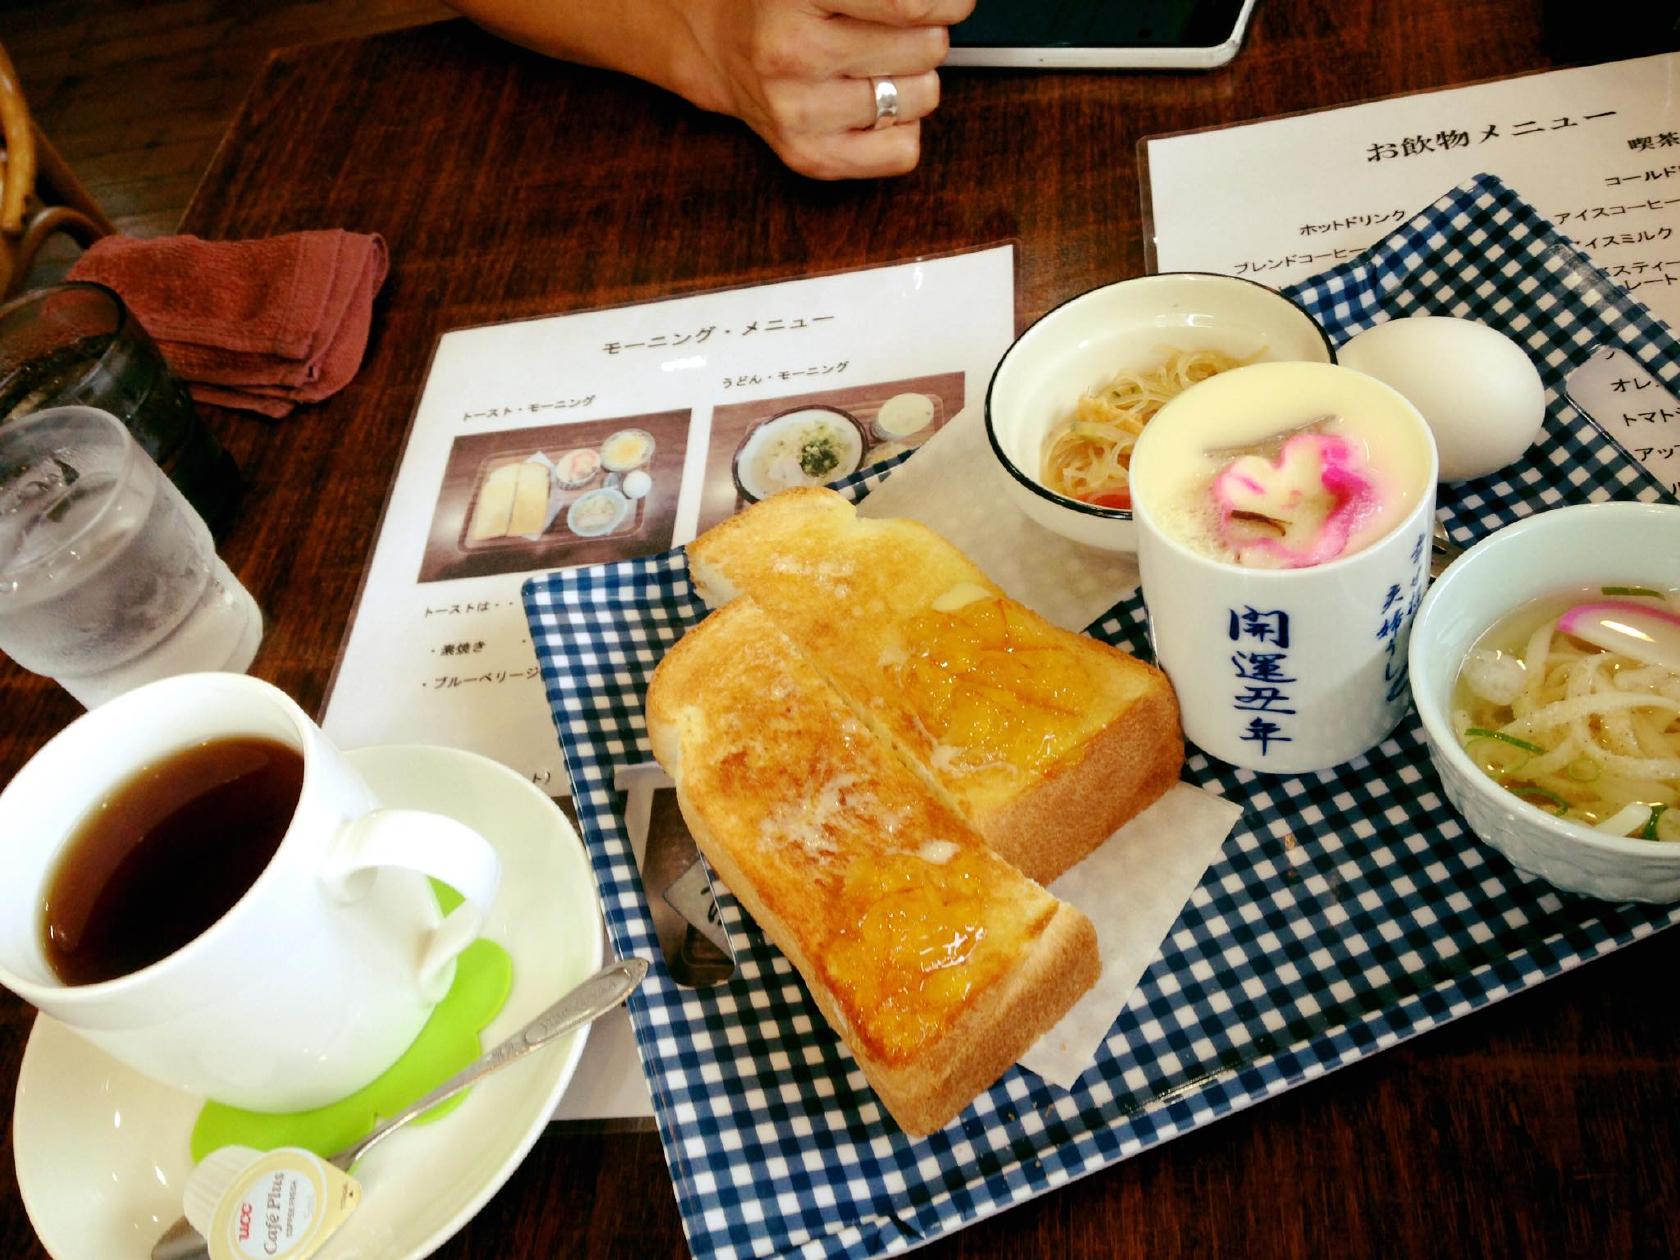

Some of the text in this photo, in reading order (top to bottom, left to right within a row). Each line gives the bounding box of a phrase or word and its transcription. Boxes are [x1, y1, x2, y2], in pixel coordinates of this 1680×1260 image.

[1366, 111, 1617, 162] お飲物メニュー
[1605, 165, 1680, 186] コールド
[1300, 210, 1405, 236] ホットドリンク
[1575, 227, 1672, 249] イスミルク
[1234, 248, 1367, 275] ブレンドコーヒー
[602, 314, 835, 355] モーニング・メニュー
[1610, 378, 1660, 393] オレ
[1623, 407, 1680, 427] トマト
[263, 1171, 285, 1256] Café Plus
